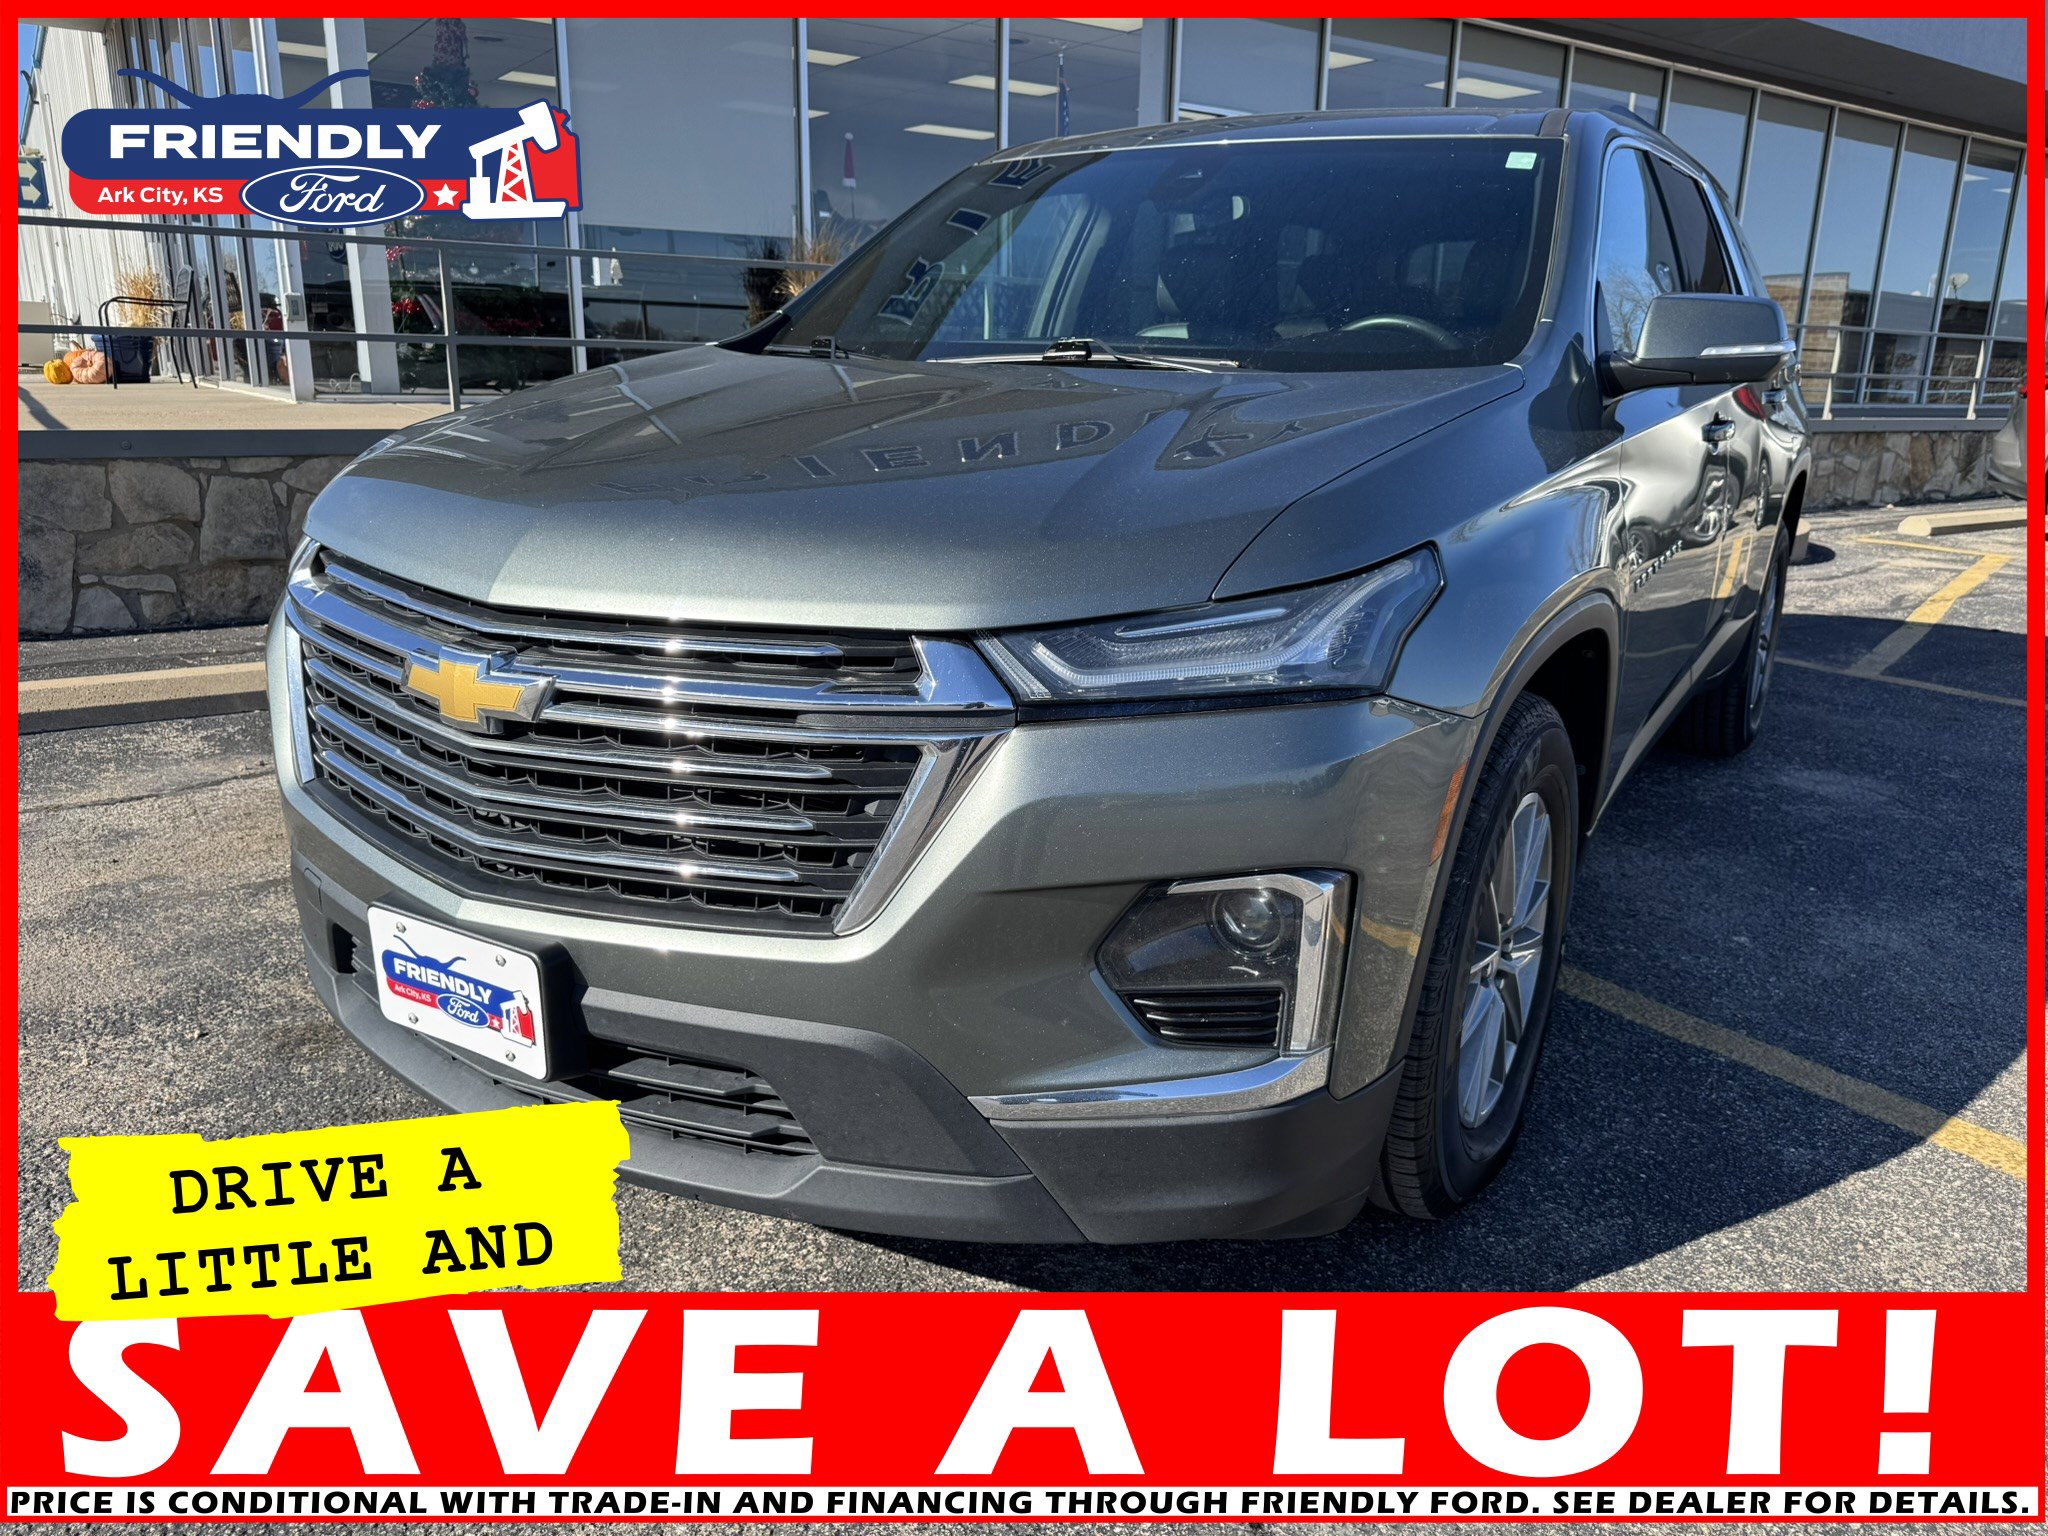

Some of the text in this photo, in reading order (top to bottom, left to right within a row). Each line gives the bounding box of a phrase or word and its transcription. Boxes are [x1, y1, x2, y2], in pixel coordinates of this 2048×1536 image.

[393, 957, 493, 1005] FRIENDLY
[394, 983, 407, 995] Ark
[446, 997, 480, 1023] Ford
